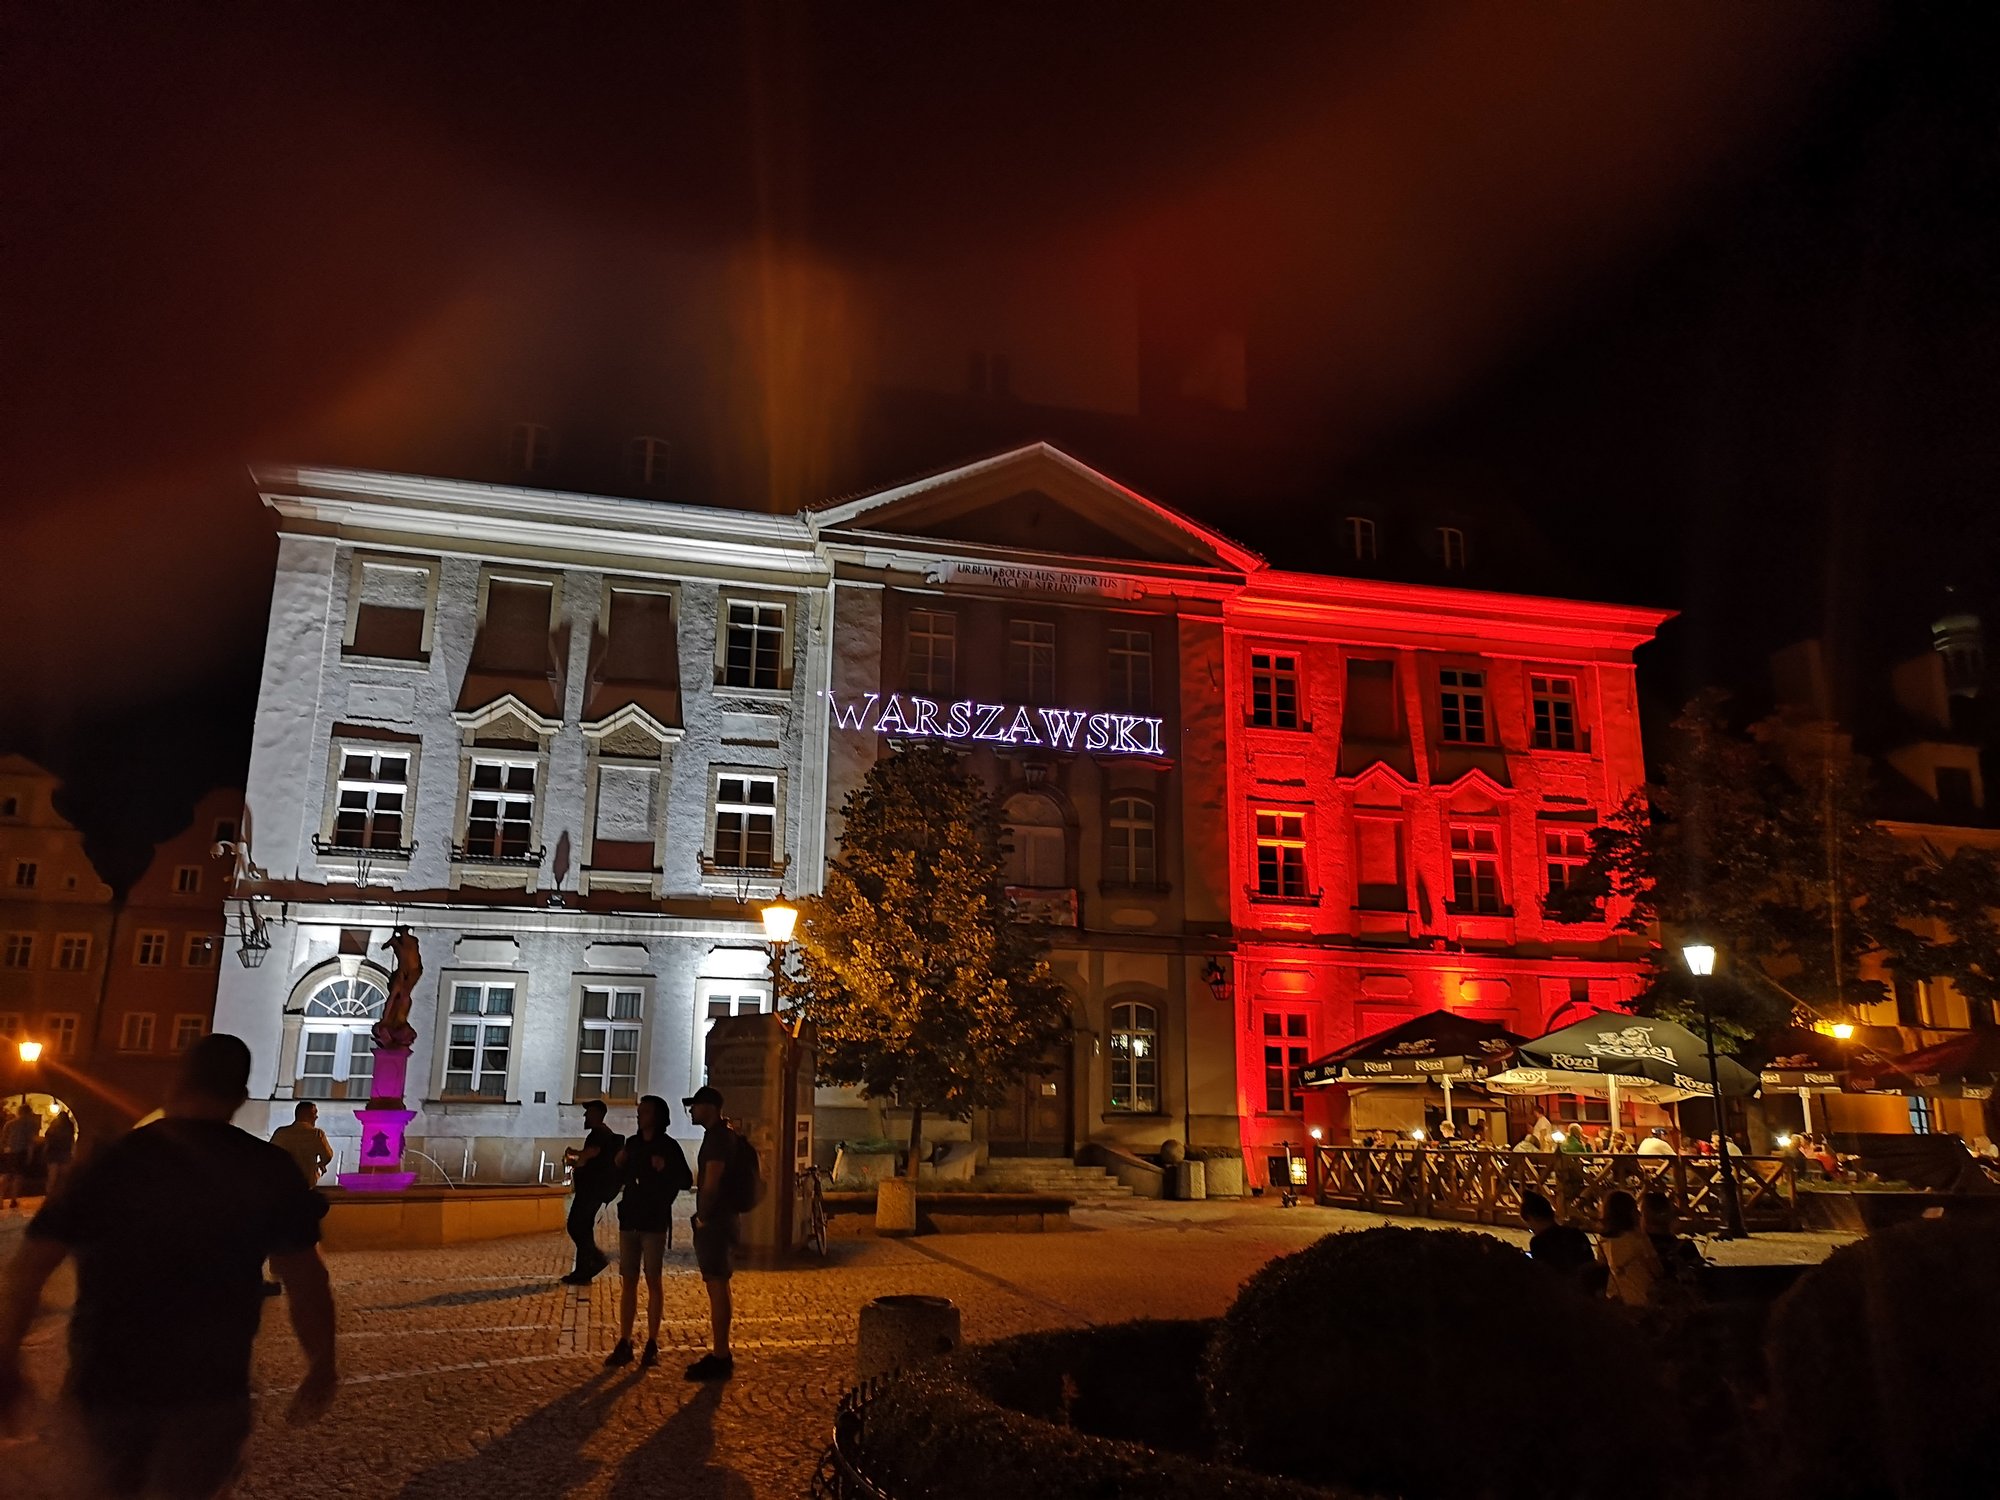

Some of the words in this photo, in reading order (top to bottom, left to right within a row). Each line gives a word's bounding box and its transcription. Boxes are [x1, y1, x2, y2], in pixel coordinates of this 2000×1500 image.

[957, 563, 992, 577] URBEM
[1060, 573, 1118, 589] DISTORTUS
[819, 689, 1165, 756] WARSZAWSKI
[1550, 1052, 1599, 1071] Kozel
[1584, 1041, 1678, 1066] Kozel
